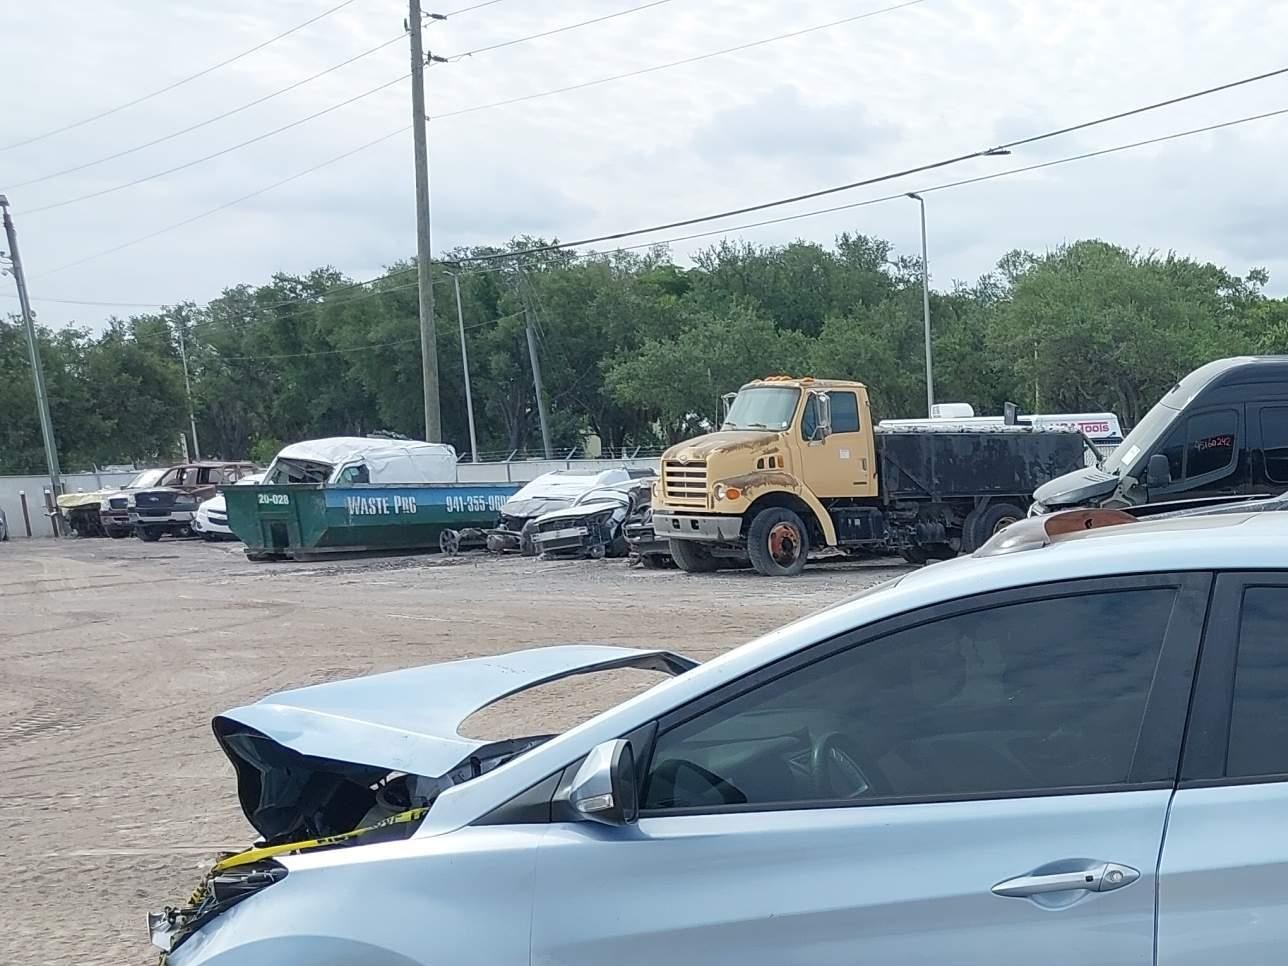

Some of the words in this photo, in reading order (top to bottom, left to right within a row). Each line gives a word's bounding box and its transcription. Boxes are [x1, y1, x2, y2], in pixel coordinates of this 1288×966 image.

[1078, 421, 1110, 433] Tools
[258, 494, 289, 505] 20-028
[347, 496, 390, 515] WASTE
